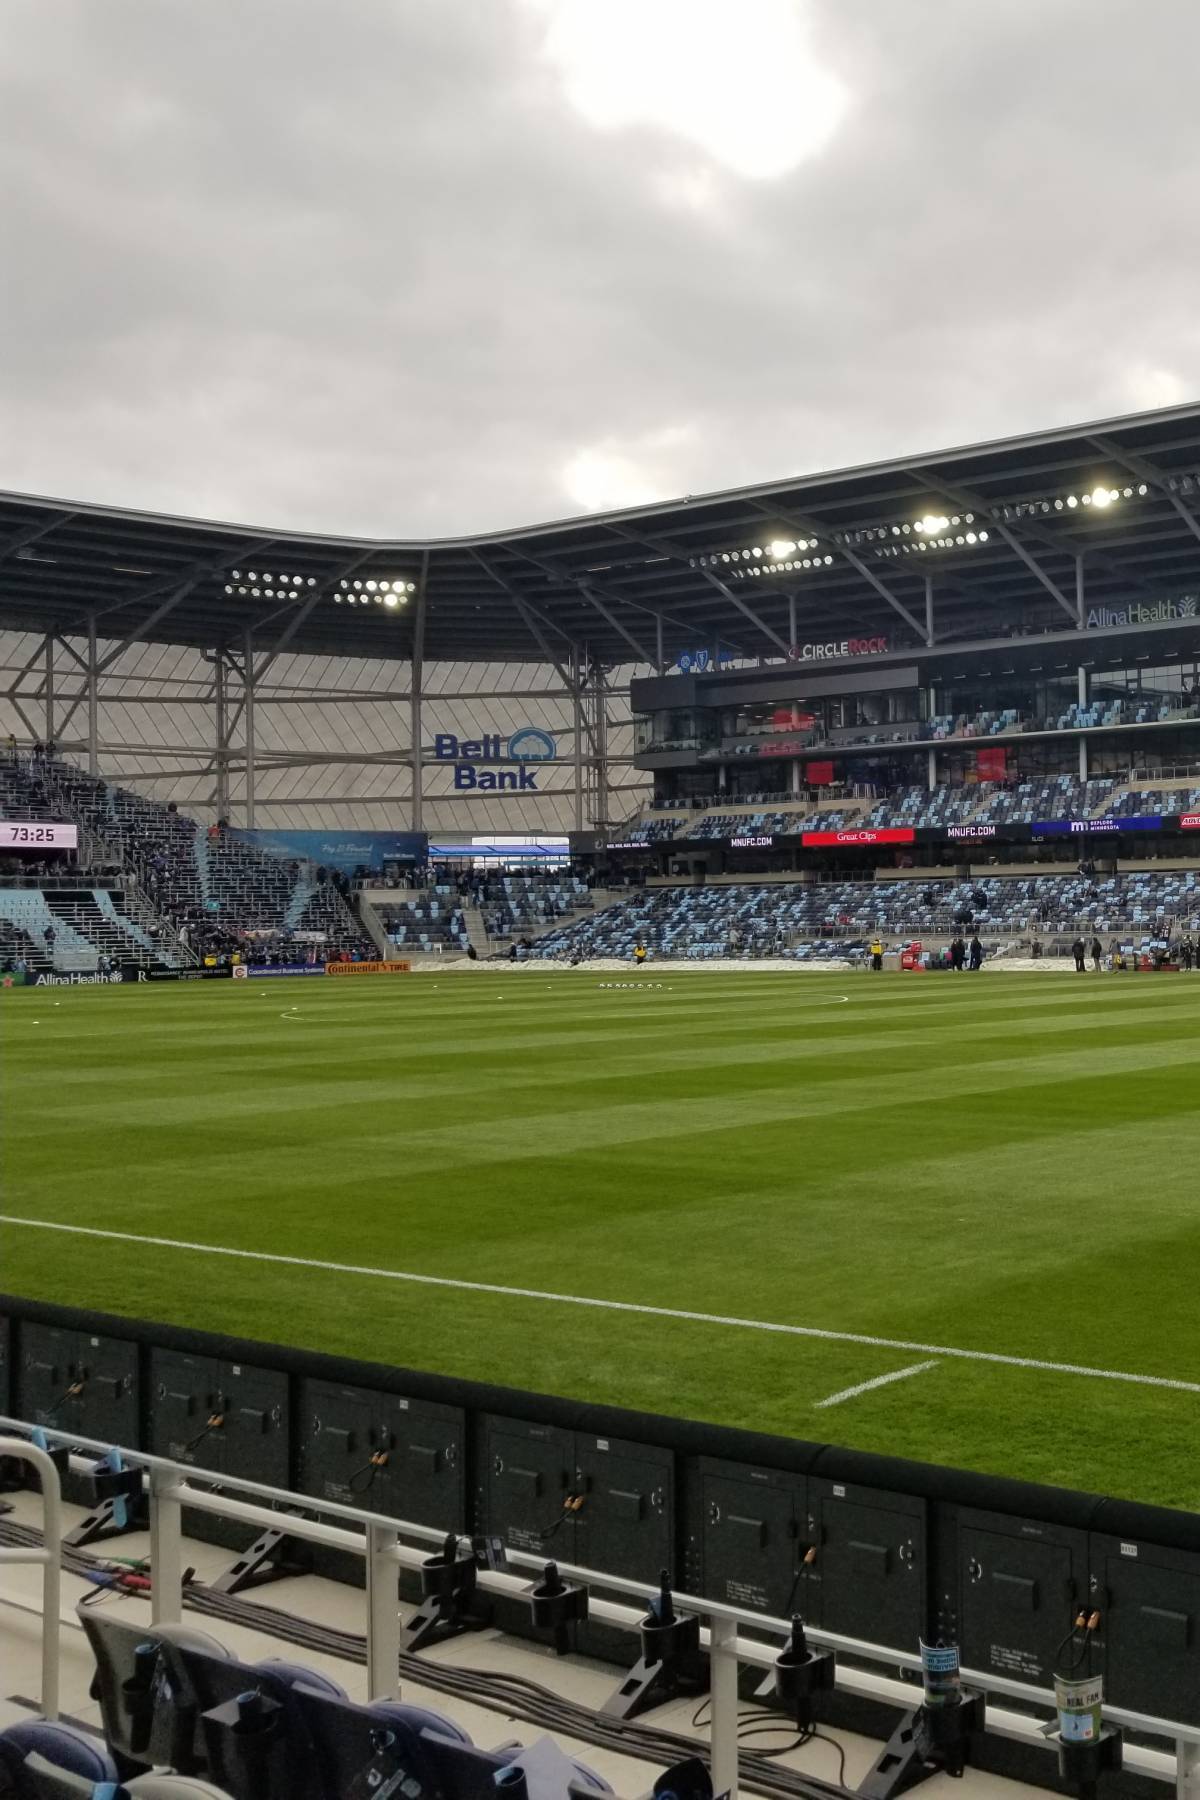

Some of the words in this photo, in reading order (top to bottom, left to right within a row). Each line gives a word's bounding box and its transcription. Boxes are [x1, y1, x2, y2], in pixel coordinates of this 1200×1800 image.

[435, 734, 500, 759] Bell
[454, 764, 538, 790] Bank
[10, 827, 54, 841] 73:25
[948, 826, 996, 837] MNUFC.COM
[731, 836, 772, 848] MNUFC.COM
[327, 962, 379, 975] Continental
[389, 963, 409, 971] TIRE
